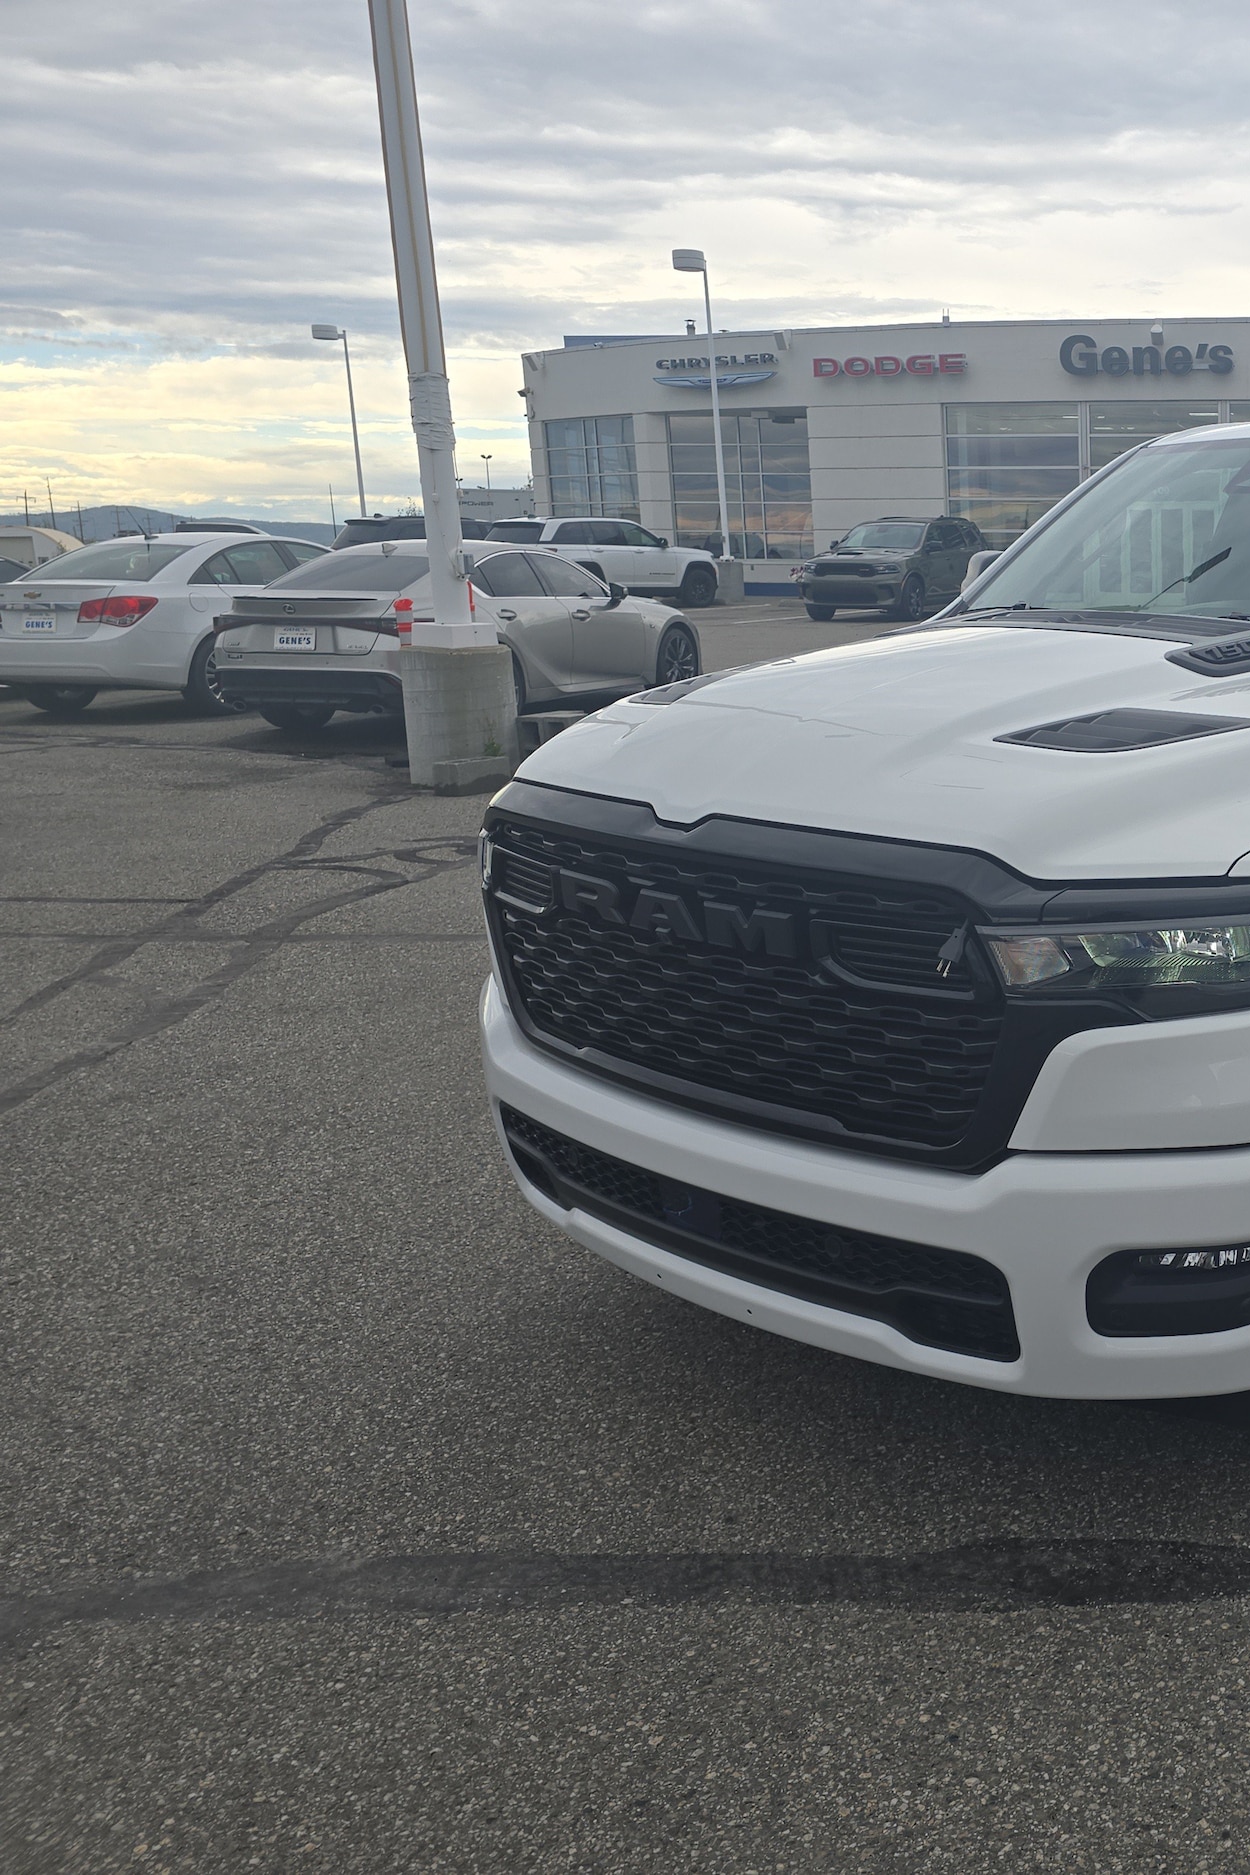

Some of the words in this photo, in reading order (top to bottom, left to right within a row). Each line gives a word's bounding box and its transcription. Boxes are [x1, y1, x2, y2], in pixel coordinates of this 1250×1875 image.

[656, 353, 778, 370] CHRYSLER
[812, 353, 967, 378] DODGE
[1059, 334, 1235, 377] Gene's
[25, 620, 53, 628] GENE'S
[279, 636, 311, 645] GENE'S
[558, 867, 798, 961] RAM
